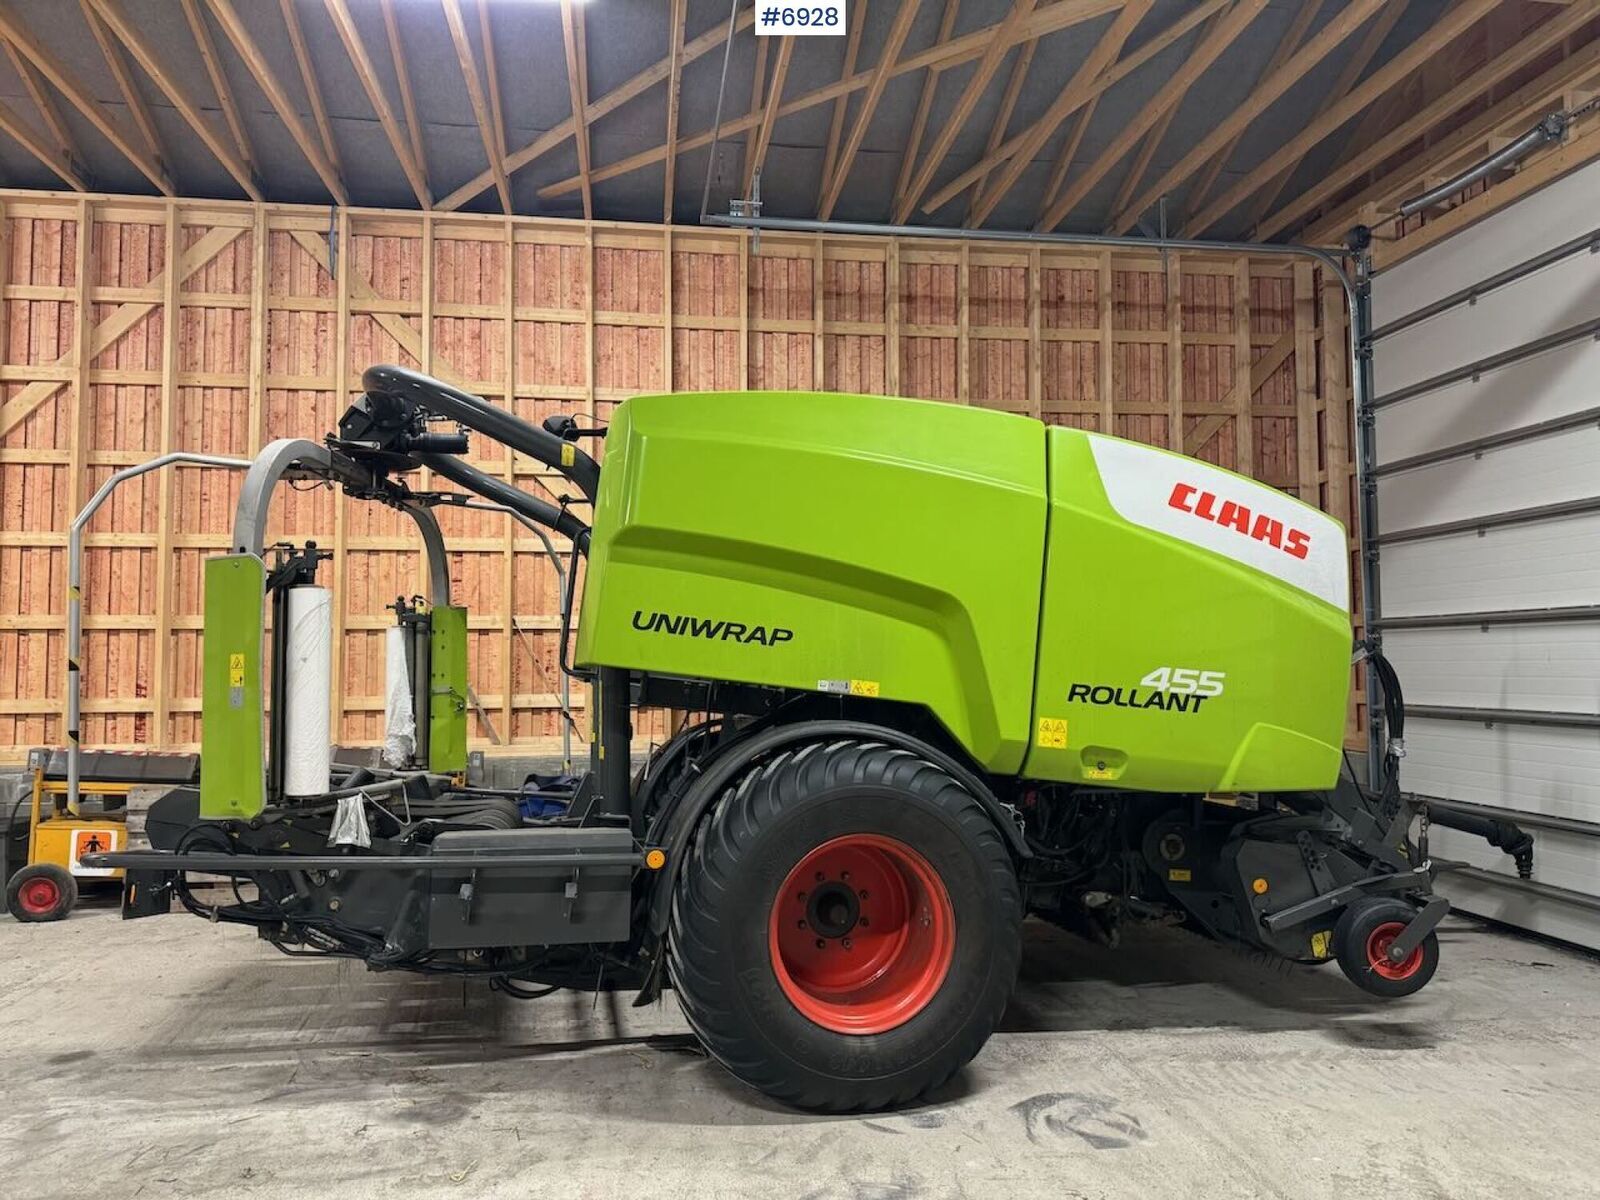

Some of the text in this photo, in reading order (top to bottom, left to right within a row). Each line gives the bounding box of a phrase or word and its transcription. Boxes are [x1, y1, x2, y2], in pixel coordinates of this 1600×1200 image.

[1168, 482, 1311, 560] CLAAS
[632, 610, 794, 647] UNIWRAP
[1067, 683, 1208, 713] ROLLANT
[1140, 666, 1226, 697] 455
